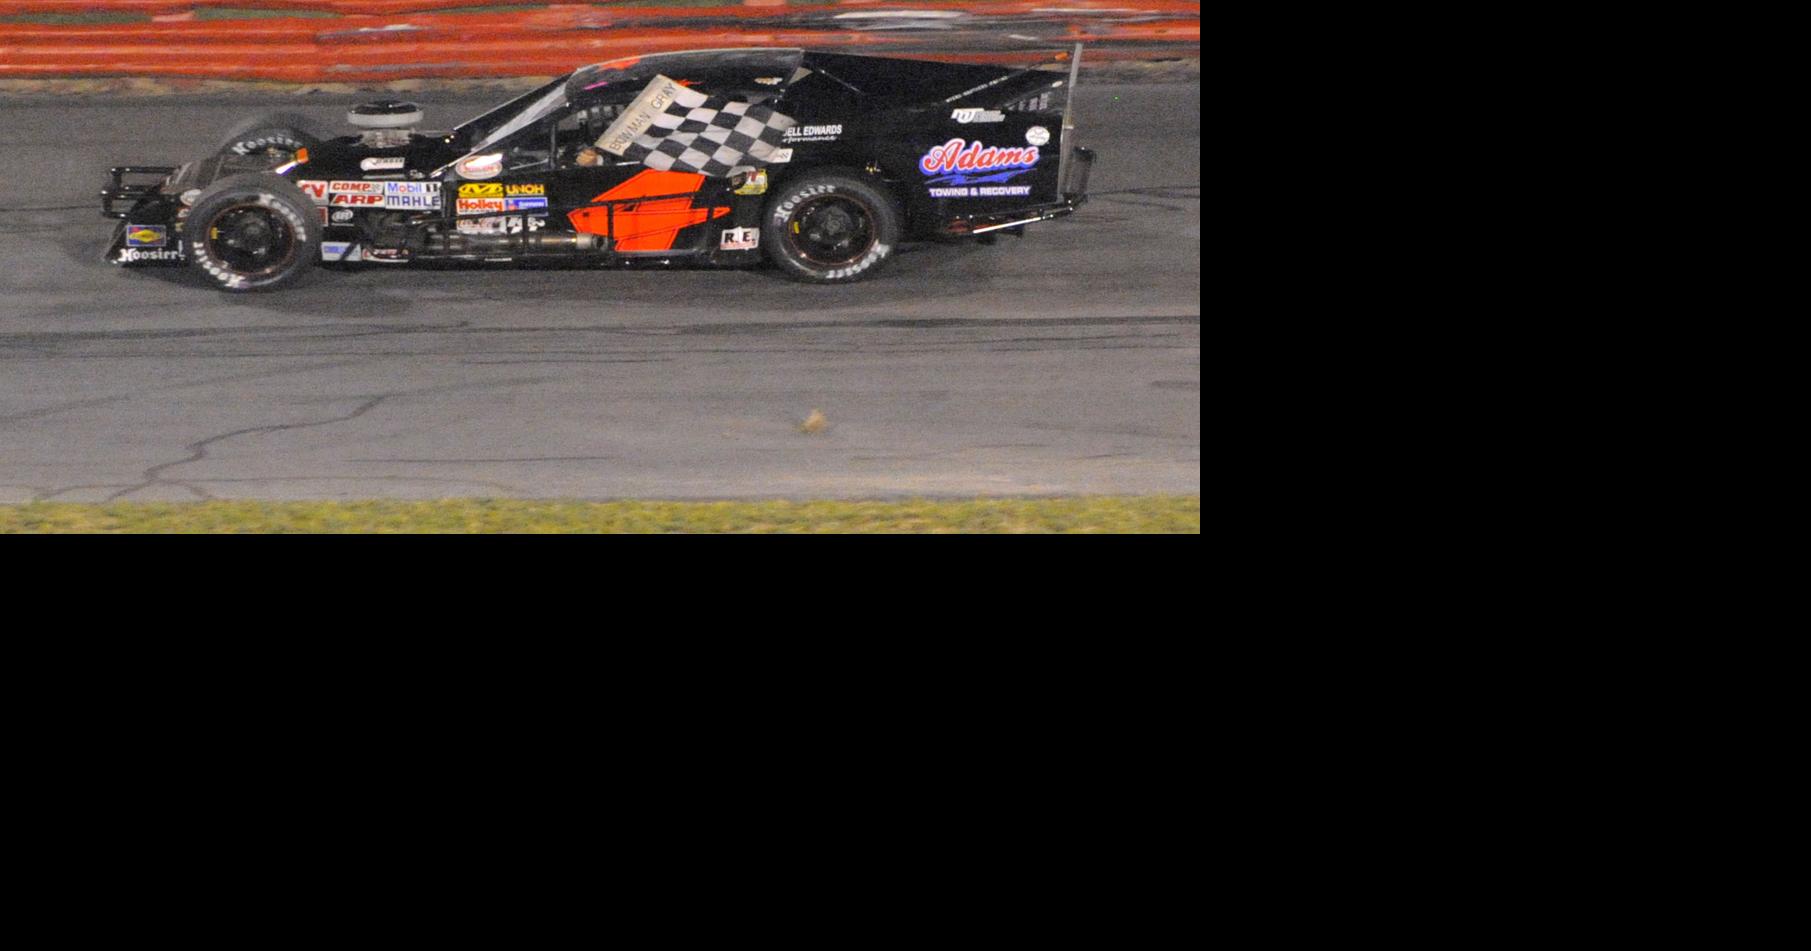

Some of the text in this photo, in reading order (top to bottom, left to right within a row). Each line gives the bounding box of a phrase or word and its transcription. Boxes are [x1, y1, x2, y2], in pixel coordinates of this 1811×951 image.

[609, 82, 676, 151] BOWMAN GRAY
[803, 124, 843, 136] EDWARDS
[920, 138, 1040, 175] Adams
[332, 182, 371, 191] COMP
[387, 183, 422, 193] Mobil
[505, 184, 545, 195] UNOH
[929, 185, 1031, 197] TOWING & RECOVERY
[334, 194, 383, 205] ARP
[387, 195, 441, 207] MAHLE
[459, 199, 502, 212] Holley
[774, 184, 836, 224] Hoosier
